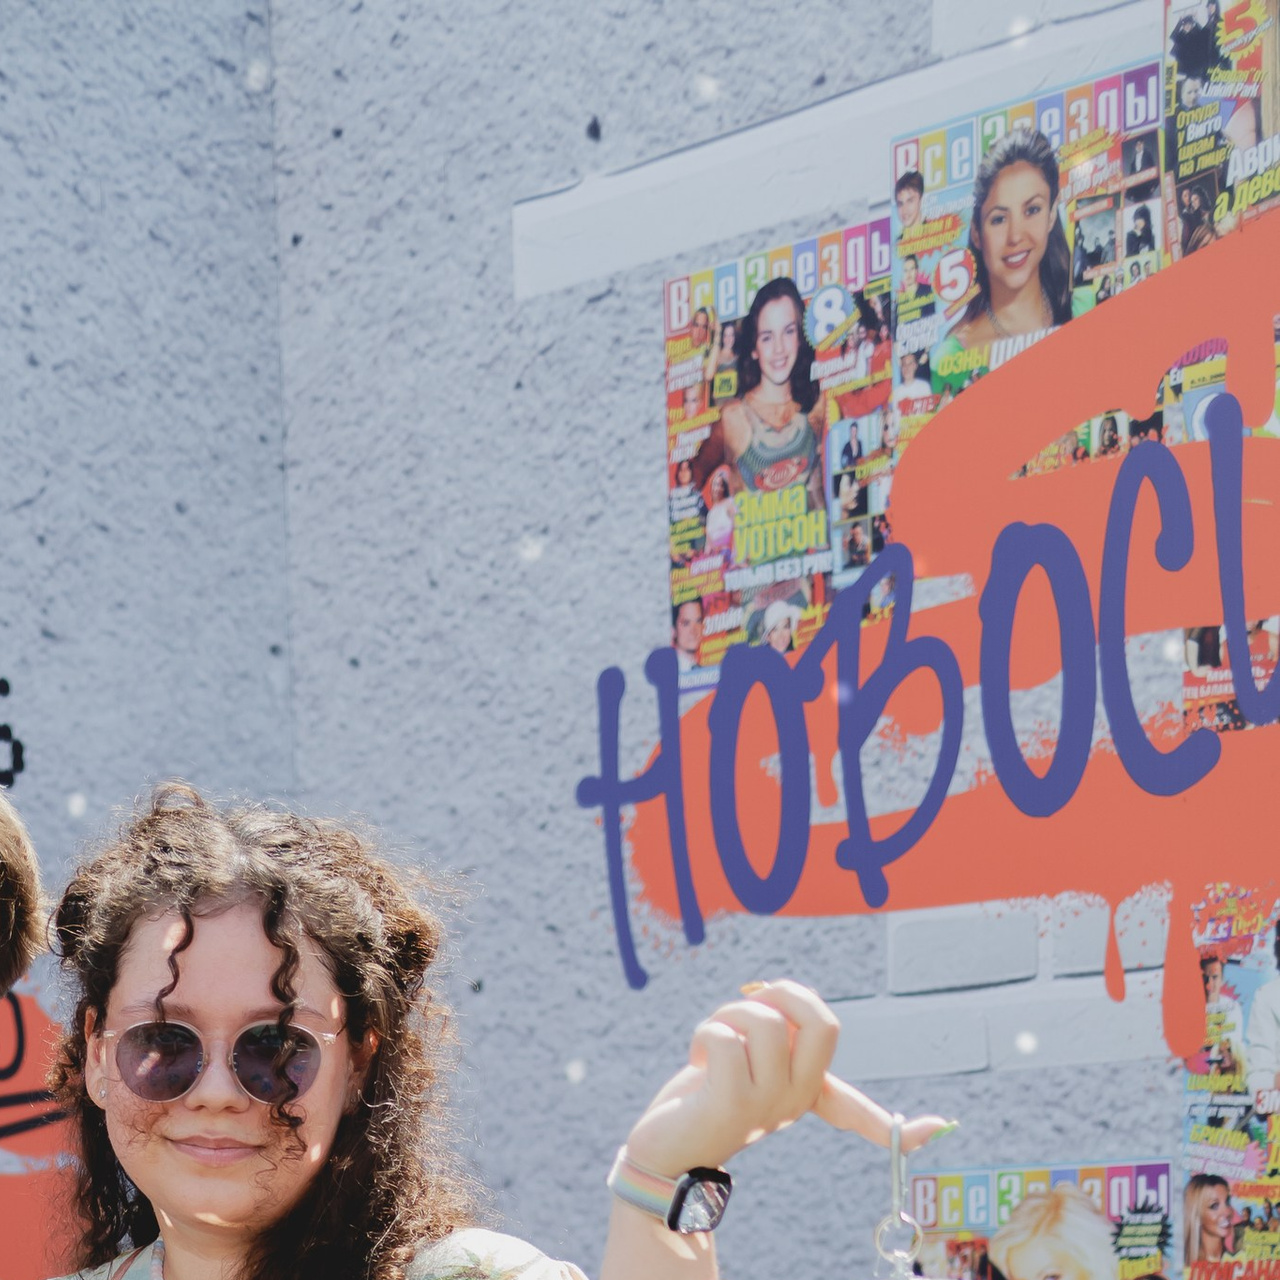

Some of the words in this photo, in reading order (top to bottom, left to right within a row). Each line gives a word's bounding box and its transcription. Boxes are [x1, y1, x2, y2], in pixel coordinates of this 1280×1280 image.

[939, 250, 971, 302] 5
[733, 508, 828, 566] УОТСОН
[916, 1176, 988, 1230] Все
